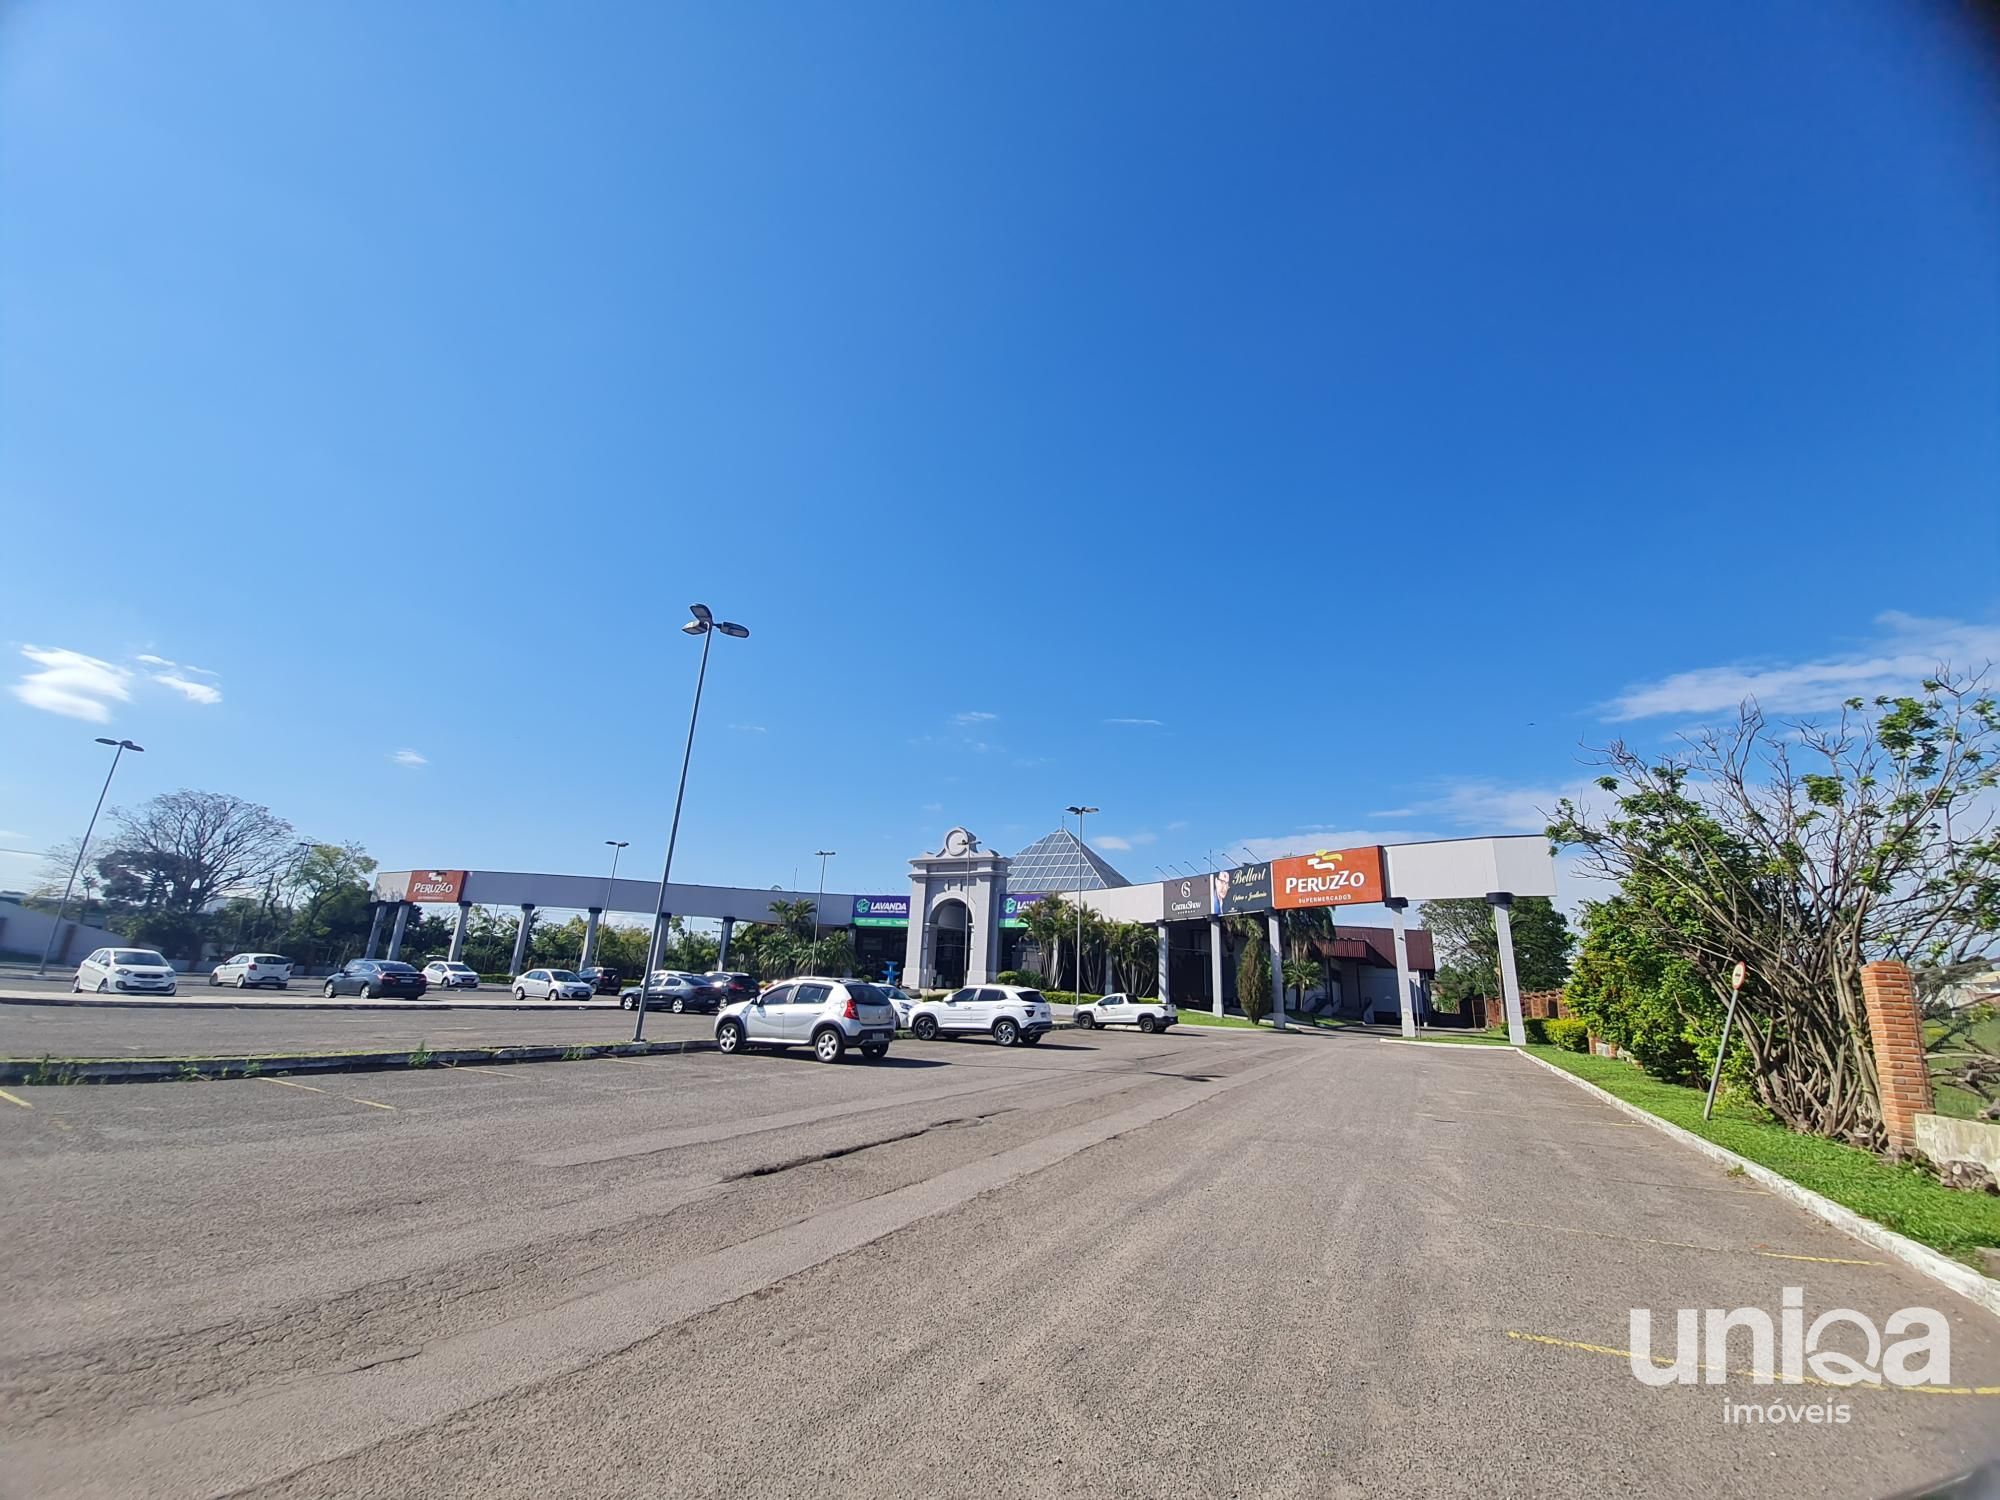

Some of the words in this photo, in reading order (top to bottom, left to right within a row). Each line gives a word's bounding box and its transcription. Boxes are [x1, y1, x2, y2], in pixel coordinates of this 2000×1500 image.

[413, 882, 454, 894] PERUZZO
[1285, 870, 1365, 894] PERUZZO
[871, 902, 907, 910] LAVANDA
